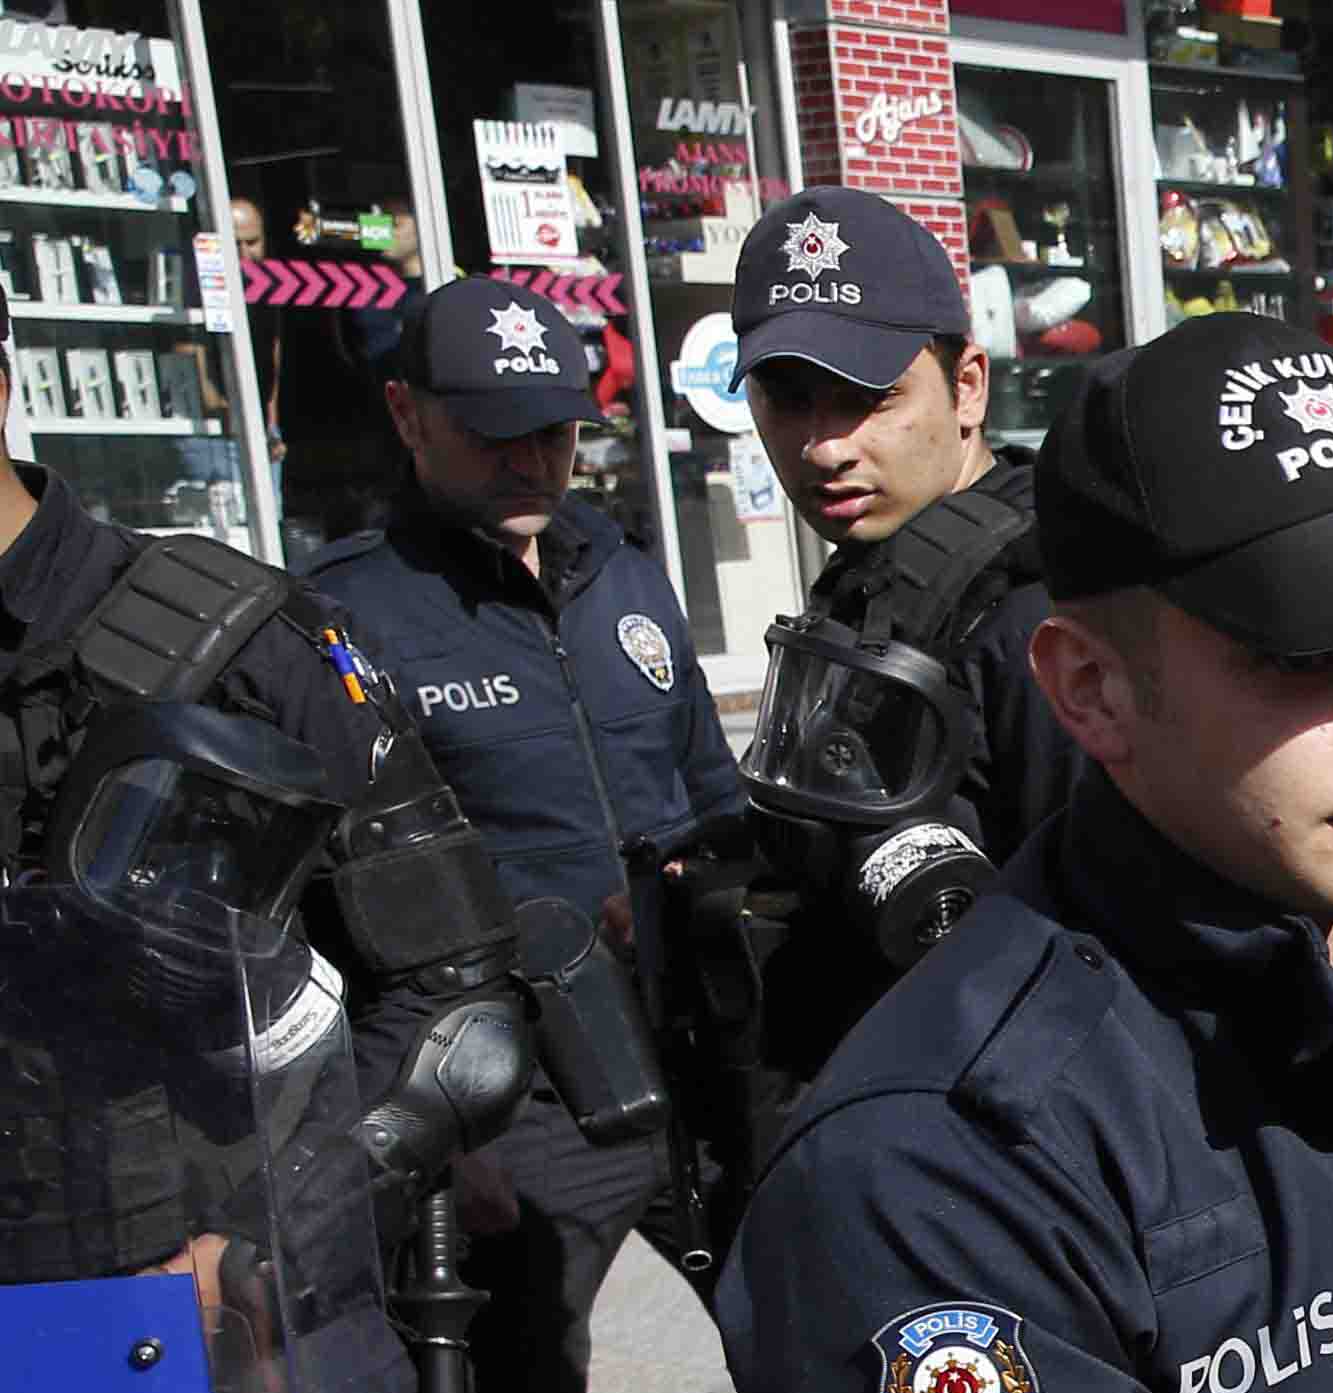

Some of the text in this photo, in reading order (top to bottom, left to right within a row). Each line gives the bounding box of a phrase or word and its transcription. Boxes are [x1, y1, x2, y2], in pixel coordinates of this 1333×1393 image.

[656, 98, 757, 135] LAMY
[856, 91, 943, 143] Ajans
[1218, 362, 1279, 450] ÇEVİK
